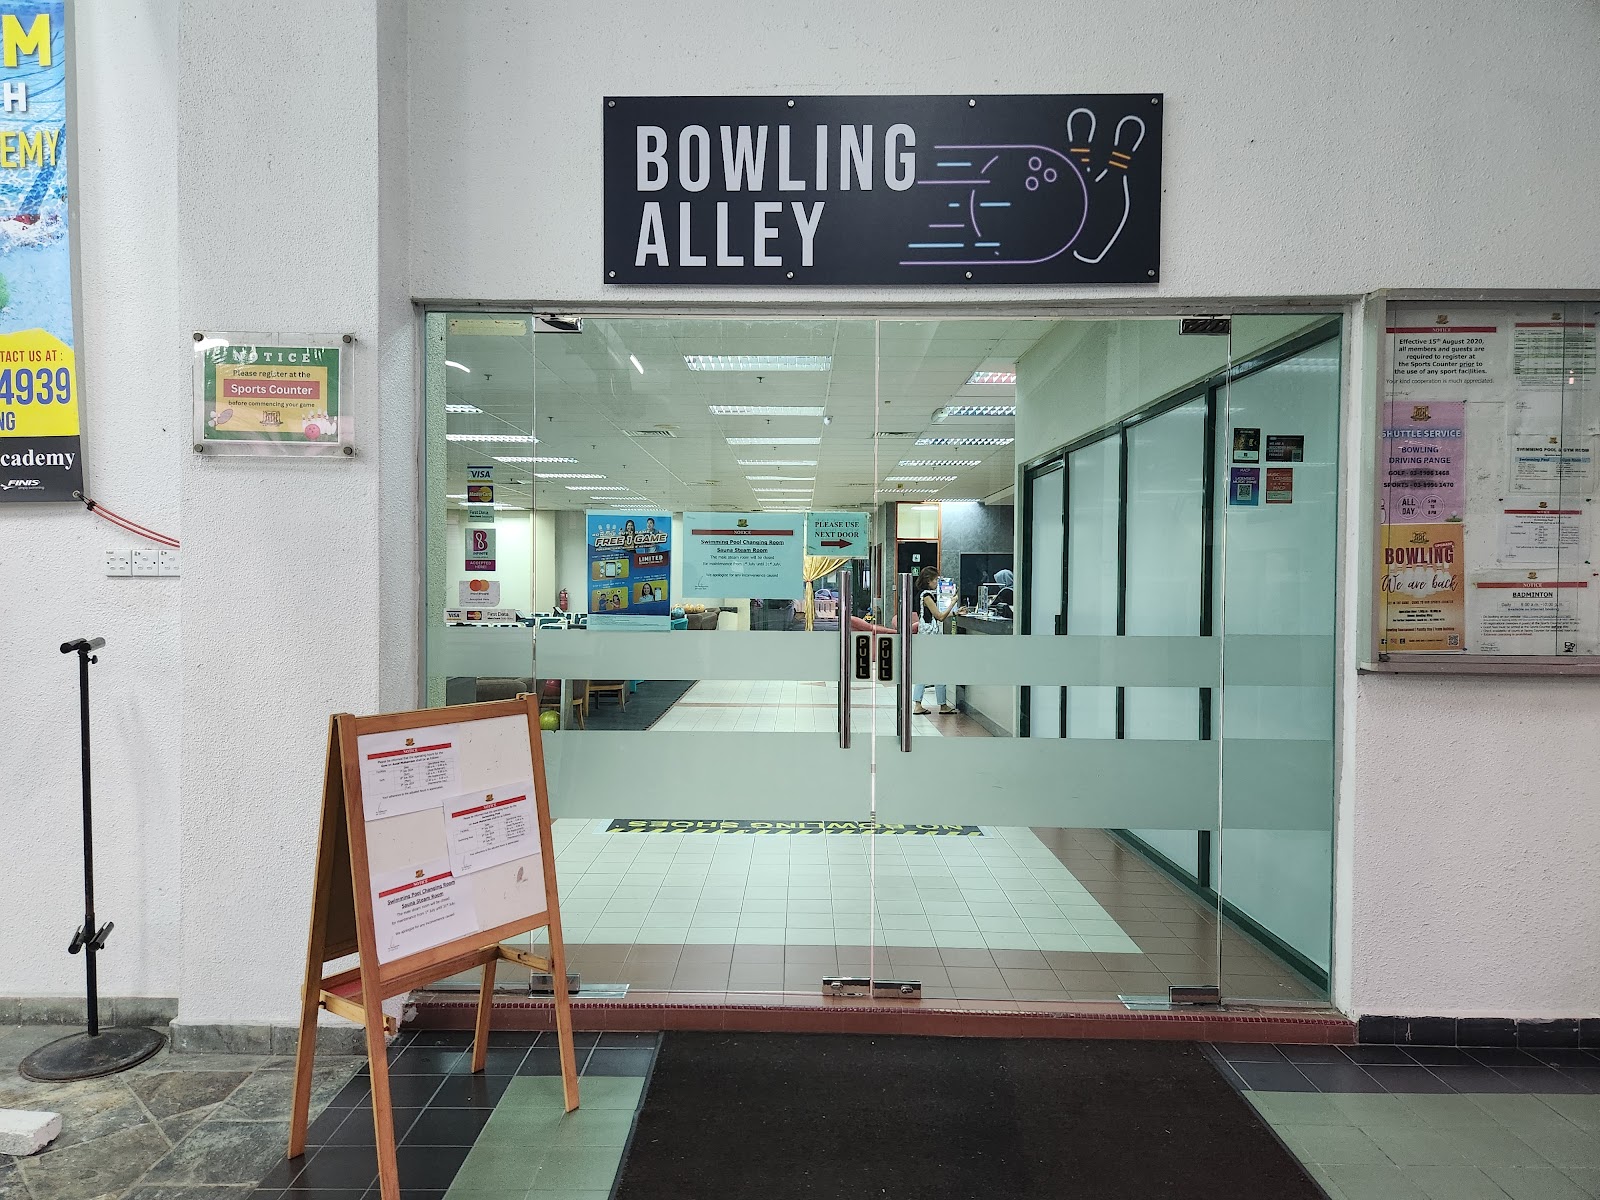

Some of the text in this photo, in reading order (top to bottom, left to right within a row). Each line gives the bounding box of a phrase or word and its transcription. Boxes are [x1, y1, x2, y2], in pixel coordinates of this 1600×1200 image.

[2, 13, 51, 67] M
[3, 82, 27, 112] H
[0, 129, 60, 168] EMY
[635, 123, 917, 192] BOWLING
[634, 201, 826, 267] ALLEY
[1442, 338, 1464, 346] August
[29, 350, 42, 362] US
[45, 350, 58, 361] AT
[232, 350, 311, 363] NOTICE
[233, 369, 257, 378] Please
[258, 370, 287, 379] register
[0, 367, 71, 405] 4939
[231, 383, 313, 396] Sports Counter
[248, 400, 285, 408] commencing
[1382, 429, 1461, 438] SHUTTLE SERVICE
[0, 449, 75, 470] cademy
[470, 470, 491, 478] VISA
[1401, 498, 1416, 506] ALL
[1401, 507, 1416, 515] DAY
[594, 536, 626, 547] FREE
[633, 533, 668, 544] GAME
[1384, 547, 1454, 566] BOWLING
[1381, 574, 1459, 593] We are back
[859, 638, 867, 677] PULL
[881, 640, 890, 678] PULL
[628, 820, 740, 829] SHOES
[387, 880, 456, 906] Swimming Pool Changing Room
[401, 900, 416, 909] Sauna
